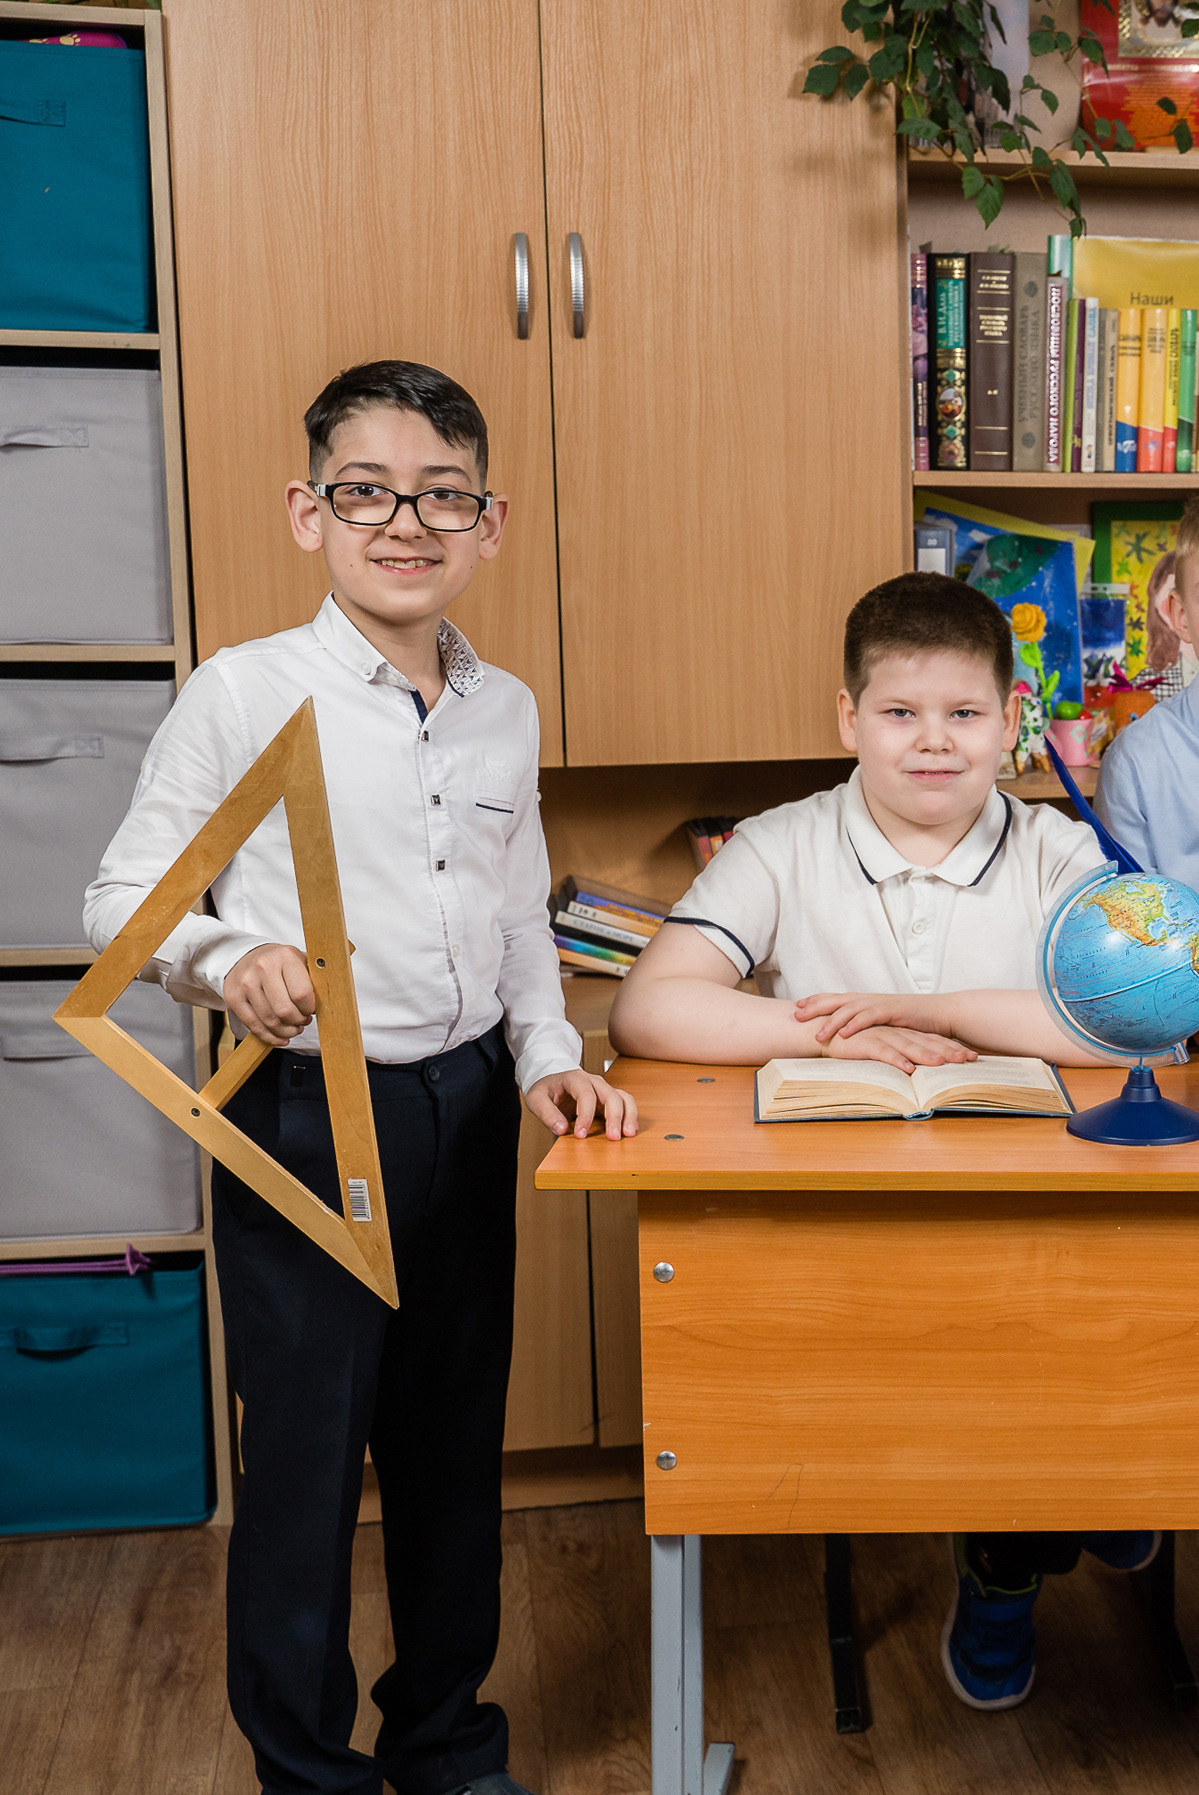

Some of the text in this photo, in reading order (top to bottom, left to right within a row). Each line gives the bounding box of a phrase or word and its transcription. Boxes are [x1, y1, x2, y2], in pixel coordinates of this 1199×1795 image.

[1130, 291, 1174, 307] Наши
[1017, 306, 1029, 424] УЧЕБНЫЙ СЛОВАРЬ
[1028, 310, 1040, 419] РУССКОГО ЯЗЫКА
[1049, 287, 1061, 462] ПОСЛОВИЦЫ РУССКОГО НАРОДА
